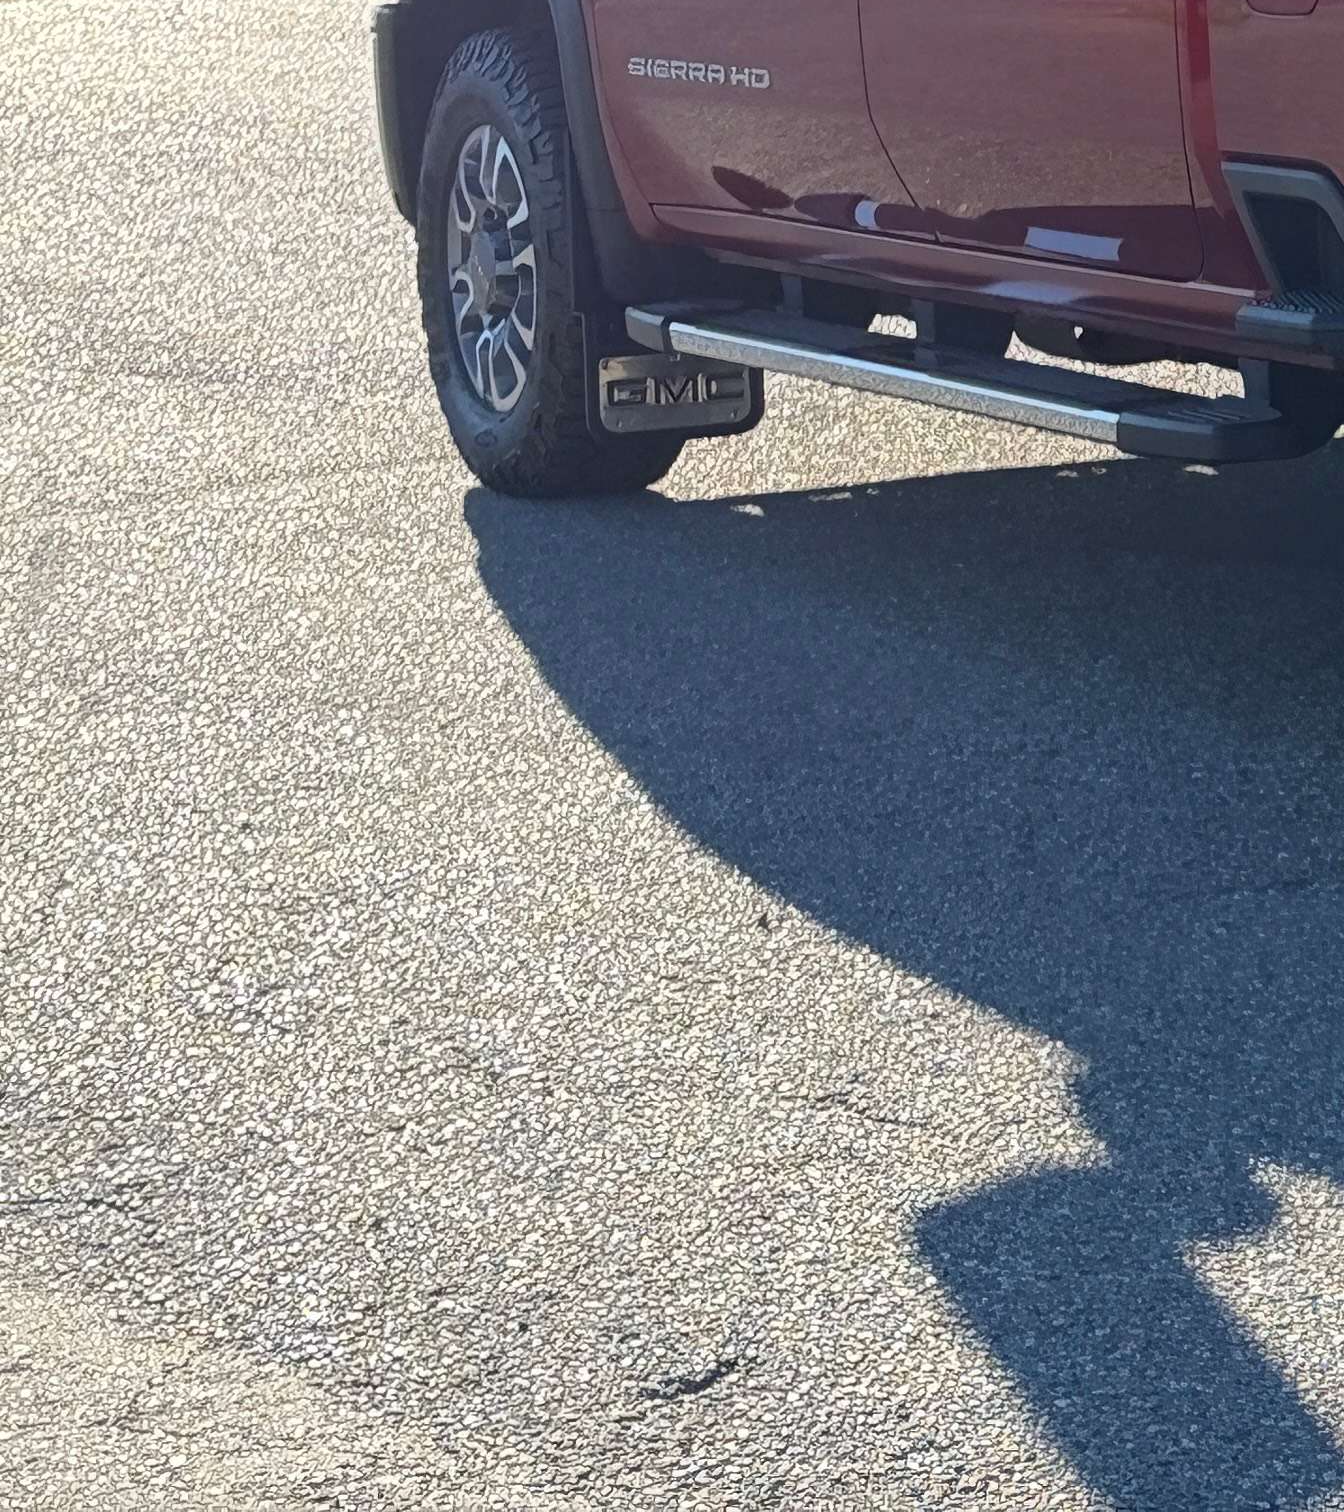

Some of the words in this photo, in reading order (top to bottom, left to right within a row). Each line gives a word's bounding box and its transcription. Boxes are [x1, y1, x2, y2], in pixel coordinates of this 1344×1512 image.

[627, 57, 725, 85] SIERRA
[730, 66, 770, 89] HD
[608, 373, 746, 407] GMC
